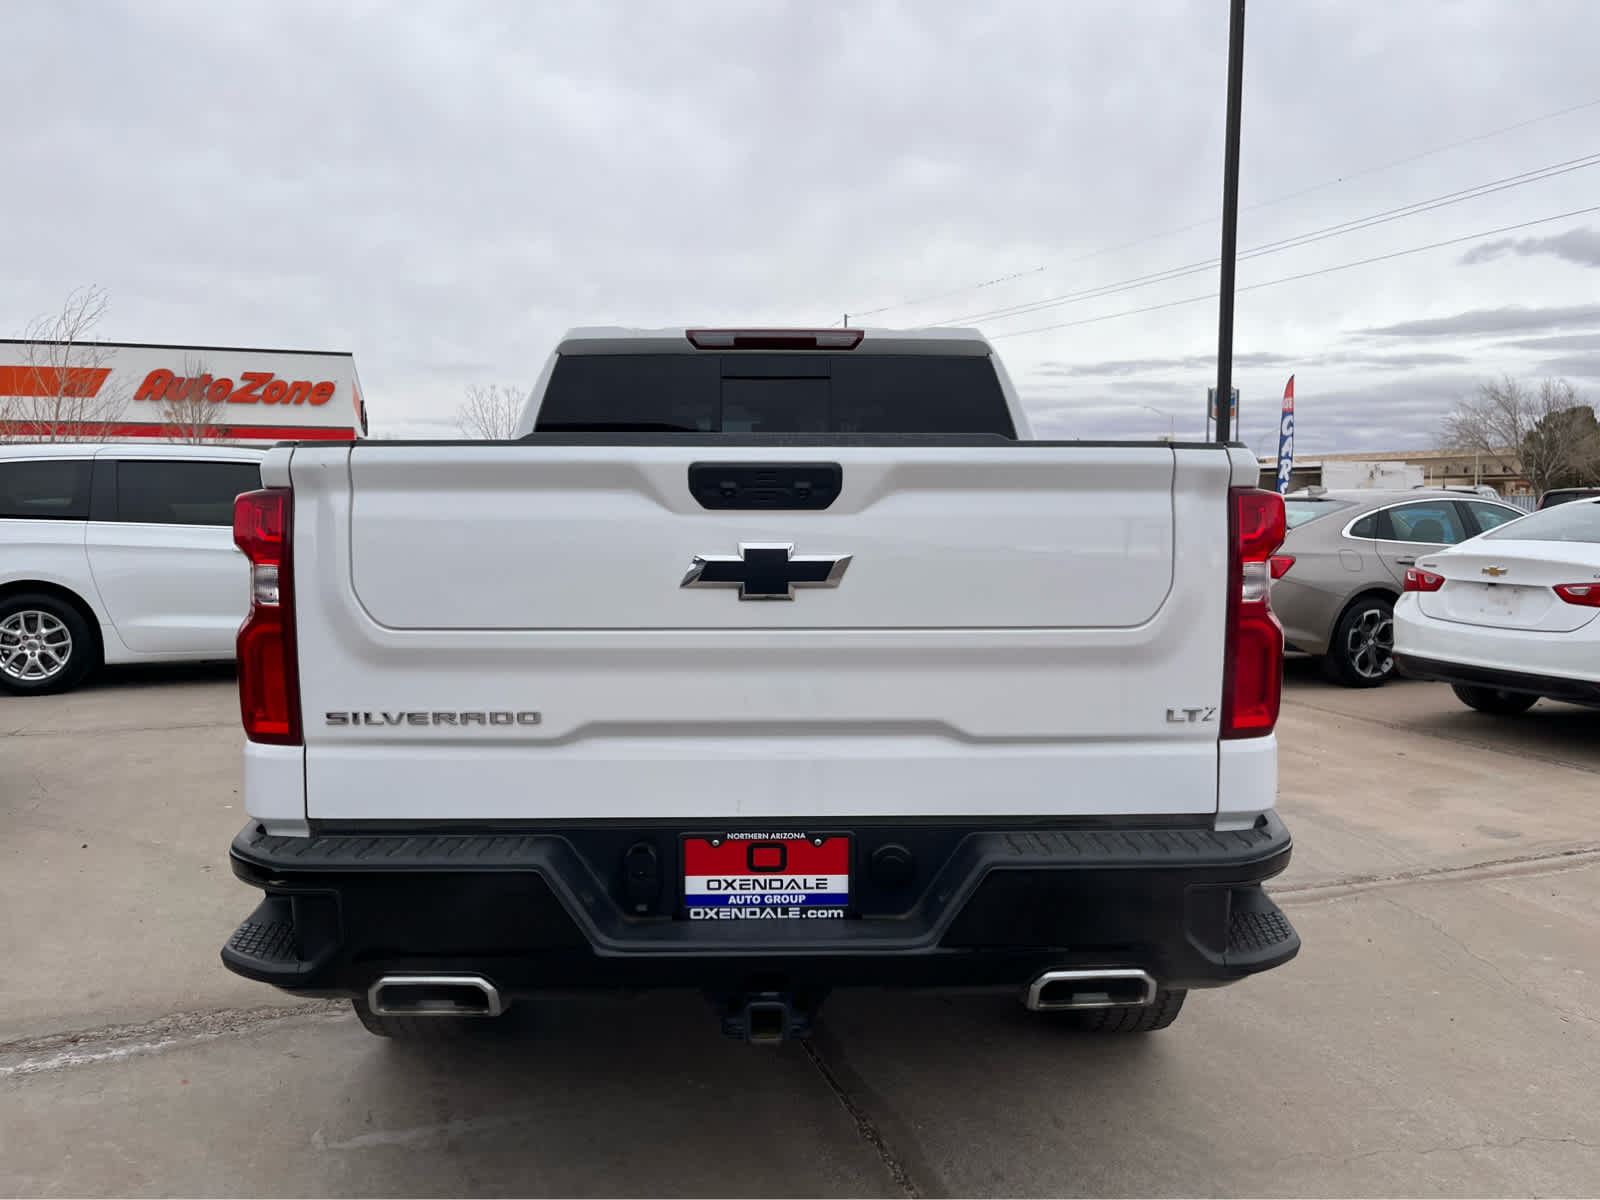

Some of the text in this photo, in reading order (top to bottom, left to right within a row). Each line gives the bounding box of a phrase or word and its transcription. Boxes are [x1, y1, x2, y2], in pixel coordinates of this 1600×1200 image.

[133, 368, 336, 405] AutoZone
[325, 711, 542, 726] SILVERADO
[1166, 706, 1217, 722] LTZ
[727, 832, 806, 840] NORTHERN ARIZONA
[706, 878, 828, 891] OXENDALE
[728, 894, 806, 905] AUTO GROUP
[689, 907, 844, 920] OXENDALE.com
